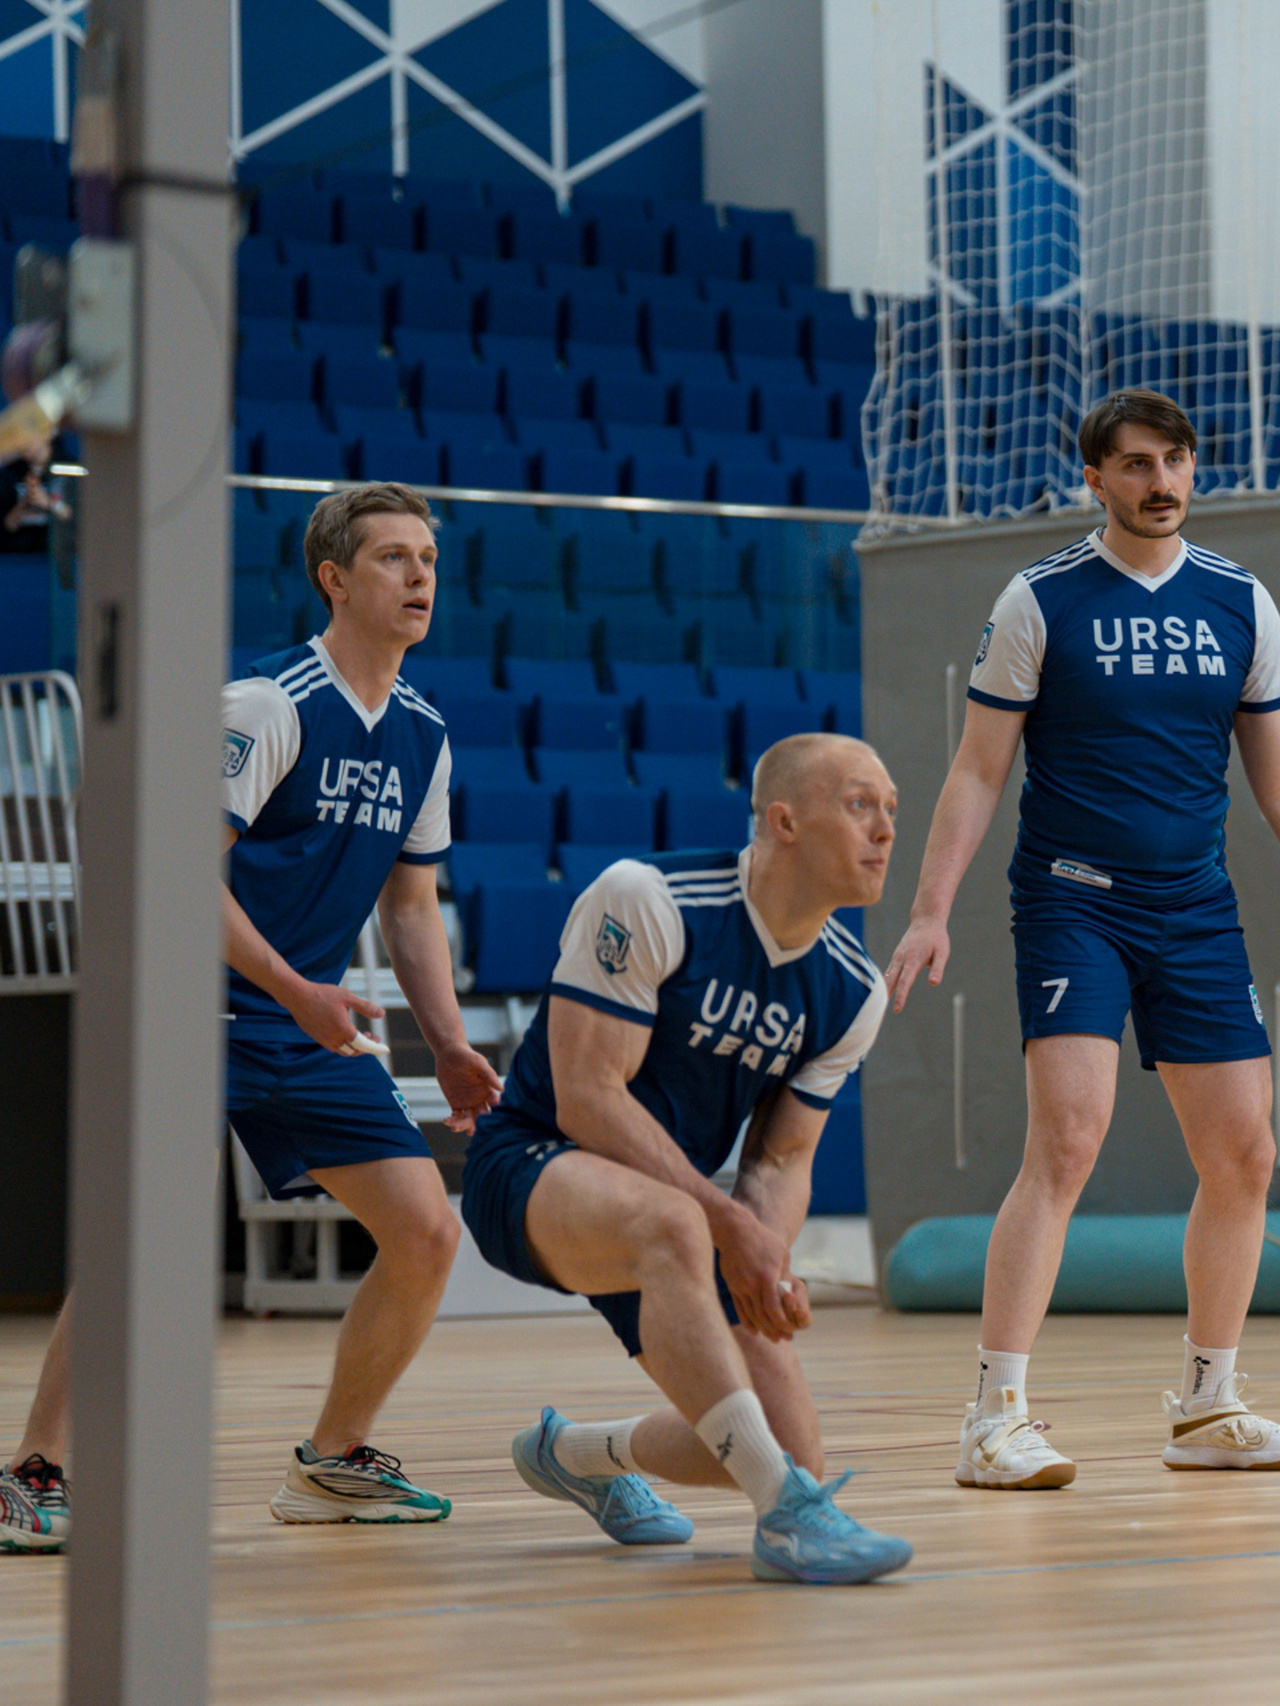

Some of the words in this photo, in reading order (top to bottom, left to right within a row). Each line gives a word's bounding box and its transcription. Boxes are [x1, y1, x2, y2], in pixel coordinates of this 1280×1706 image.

[1093, 616, 1221, 652] URSA
[1096, 654, 1226, 676] TEAM
[320, 757, 403, 807] URSA
[316, 799, 402, 834] TEAM
[1041, 977, 1069, 1013] 7
[701, 978, 806, 1054] URSA
[688, 1021, 791, 1077] TEAM
